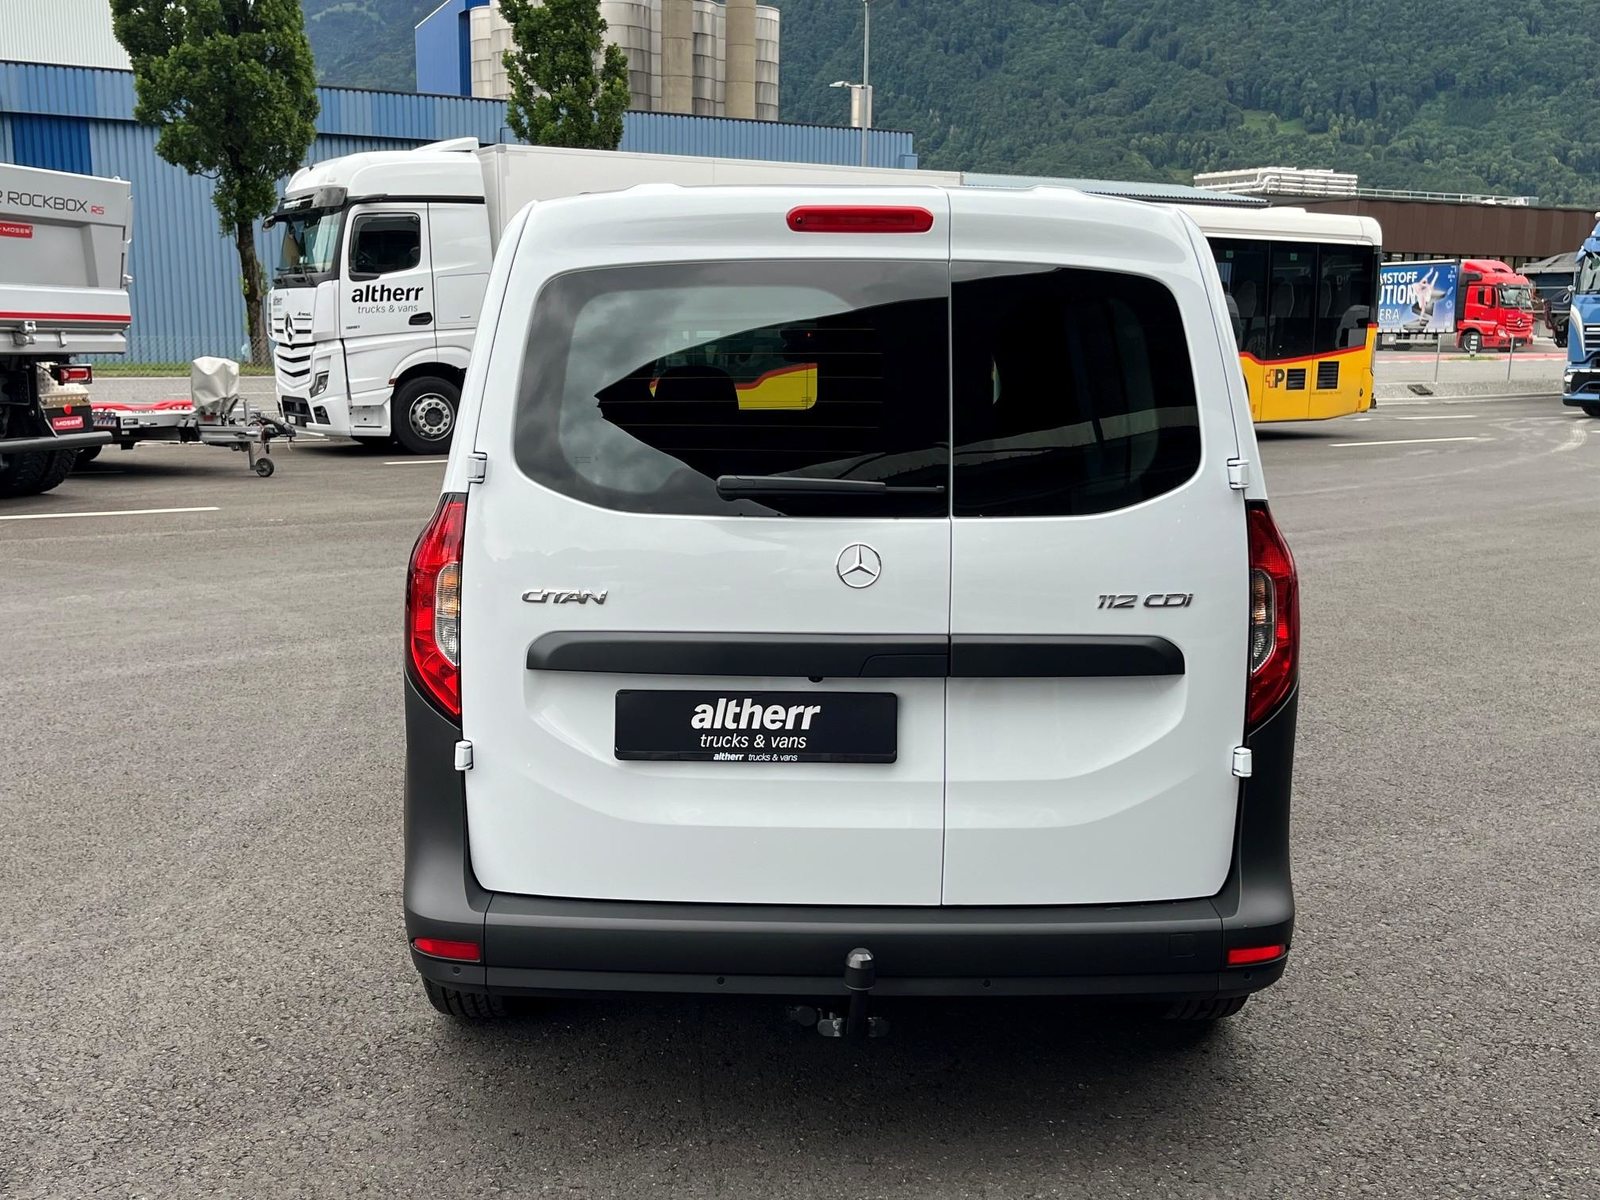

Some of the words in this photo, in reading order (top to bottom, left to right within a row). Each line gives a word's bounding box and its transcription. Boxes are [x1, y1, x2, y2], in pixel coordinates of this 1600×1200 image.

[7, 190, 88, 213] ROCKBOX
[90, 205, 105, 215] RS
[351, 284, 424, 303] altherr
[357, 302, 386, 314] trucks
[388, 304, 396, 313] &
[398, 303, 419, 313] vans
[521, 589, 608, 605] CITAN
[1097, 593, 1138, 609] 112
[691, 698, 821, 730] altherr
[700, 733, 749, 748] trucks
[753, 734, 766, 748] &
[771, 736, 807, 749] vans
[713, 752, 744, 761] altherr
[748, 752, 771, 761] trucks
[771, 753, 778, 761] &
[780, 754, 798, 762] vans
